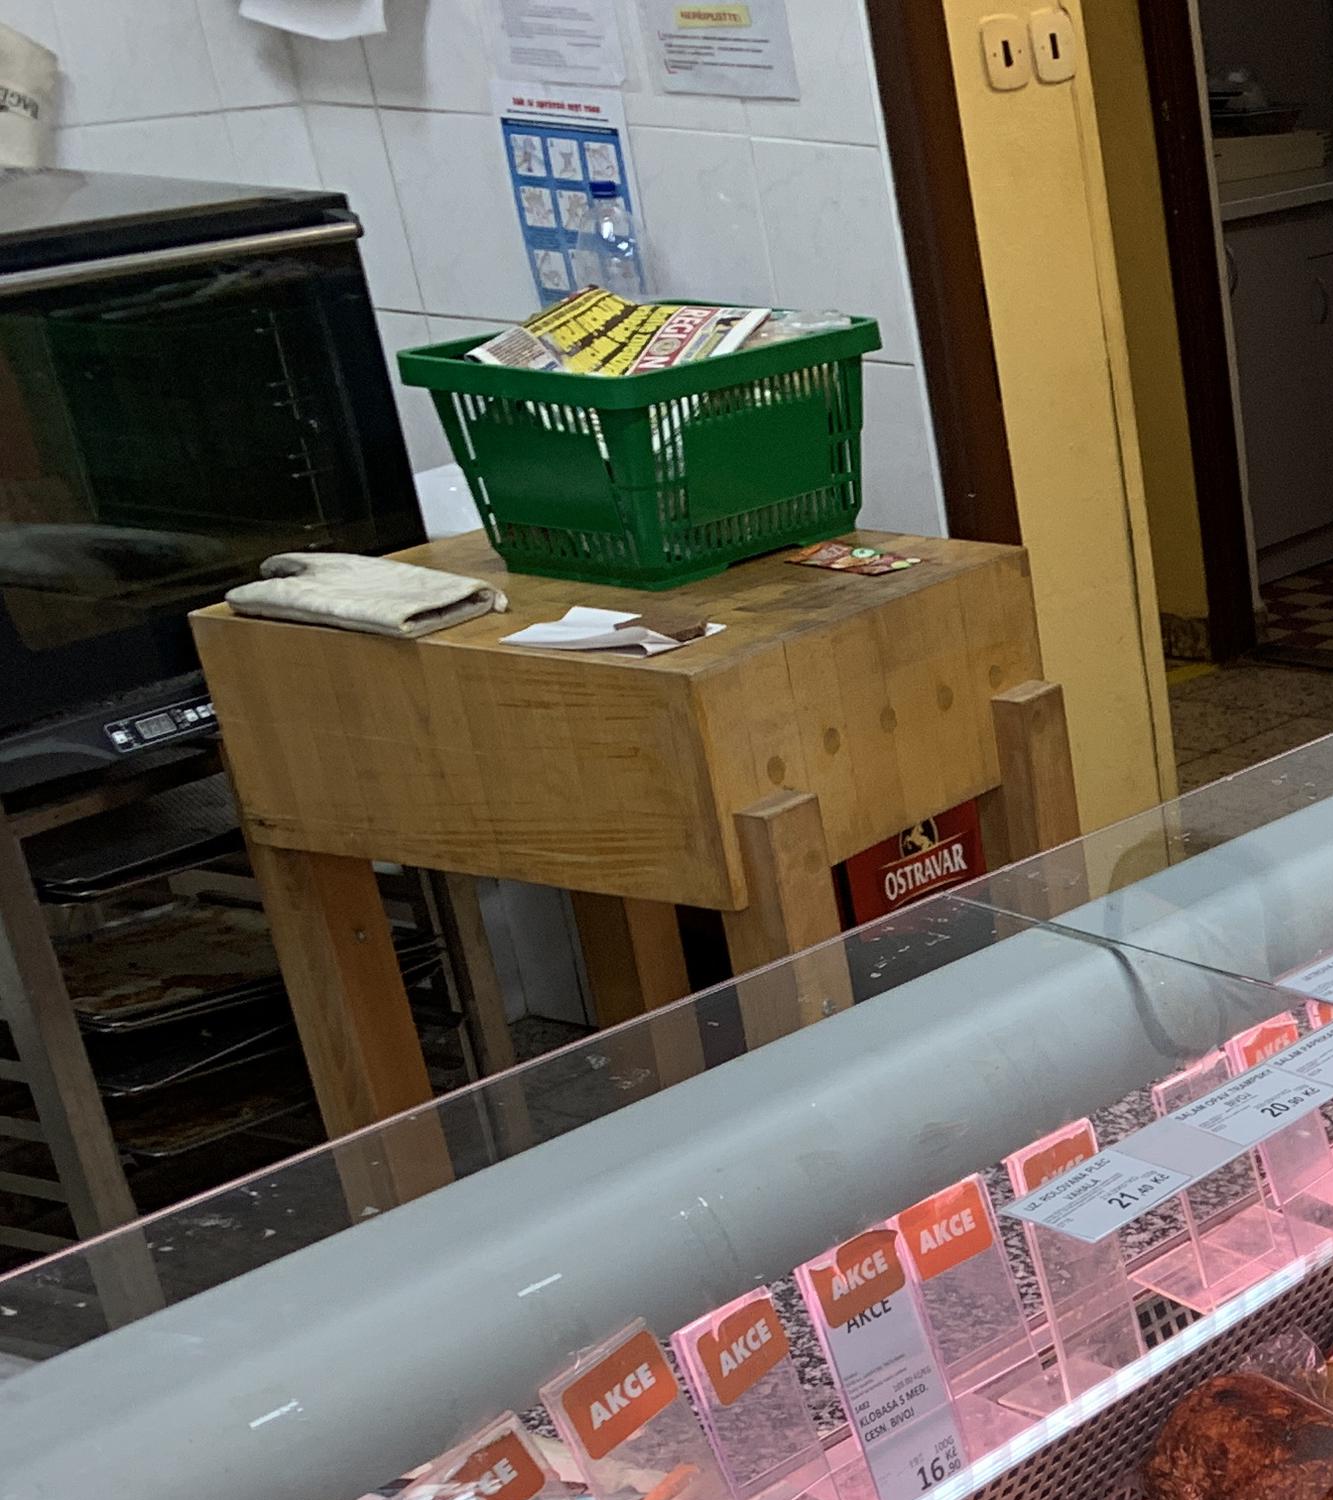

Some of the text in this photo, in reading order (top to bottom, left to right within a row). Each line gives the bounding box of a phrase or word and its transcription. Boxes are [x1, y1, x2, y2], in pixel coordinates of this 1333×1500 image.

[884, 843, 968, 901] OSTRAVAR
[918, 1207, 977, 1256] AKCE
[831, 1249, 889, 1302] AKCE
[717, 1316, 775, 1379] AKCE
[589, 1361, 657, 1432] AKCE
[859, 1397, 901, 1429] KLOBASA
[889, 1408, 915, 1430] BIVOJ
[915, 1457, 947, 1492] 16
